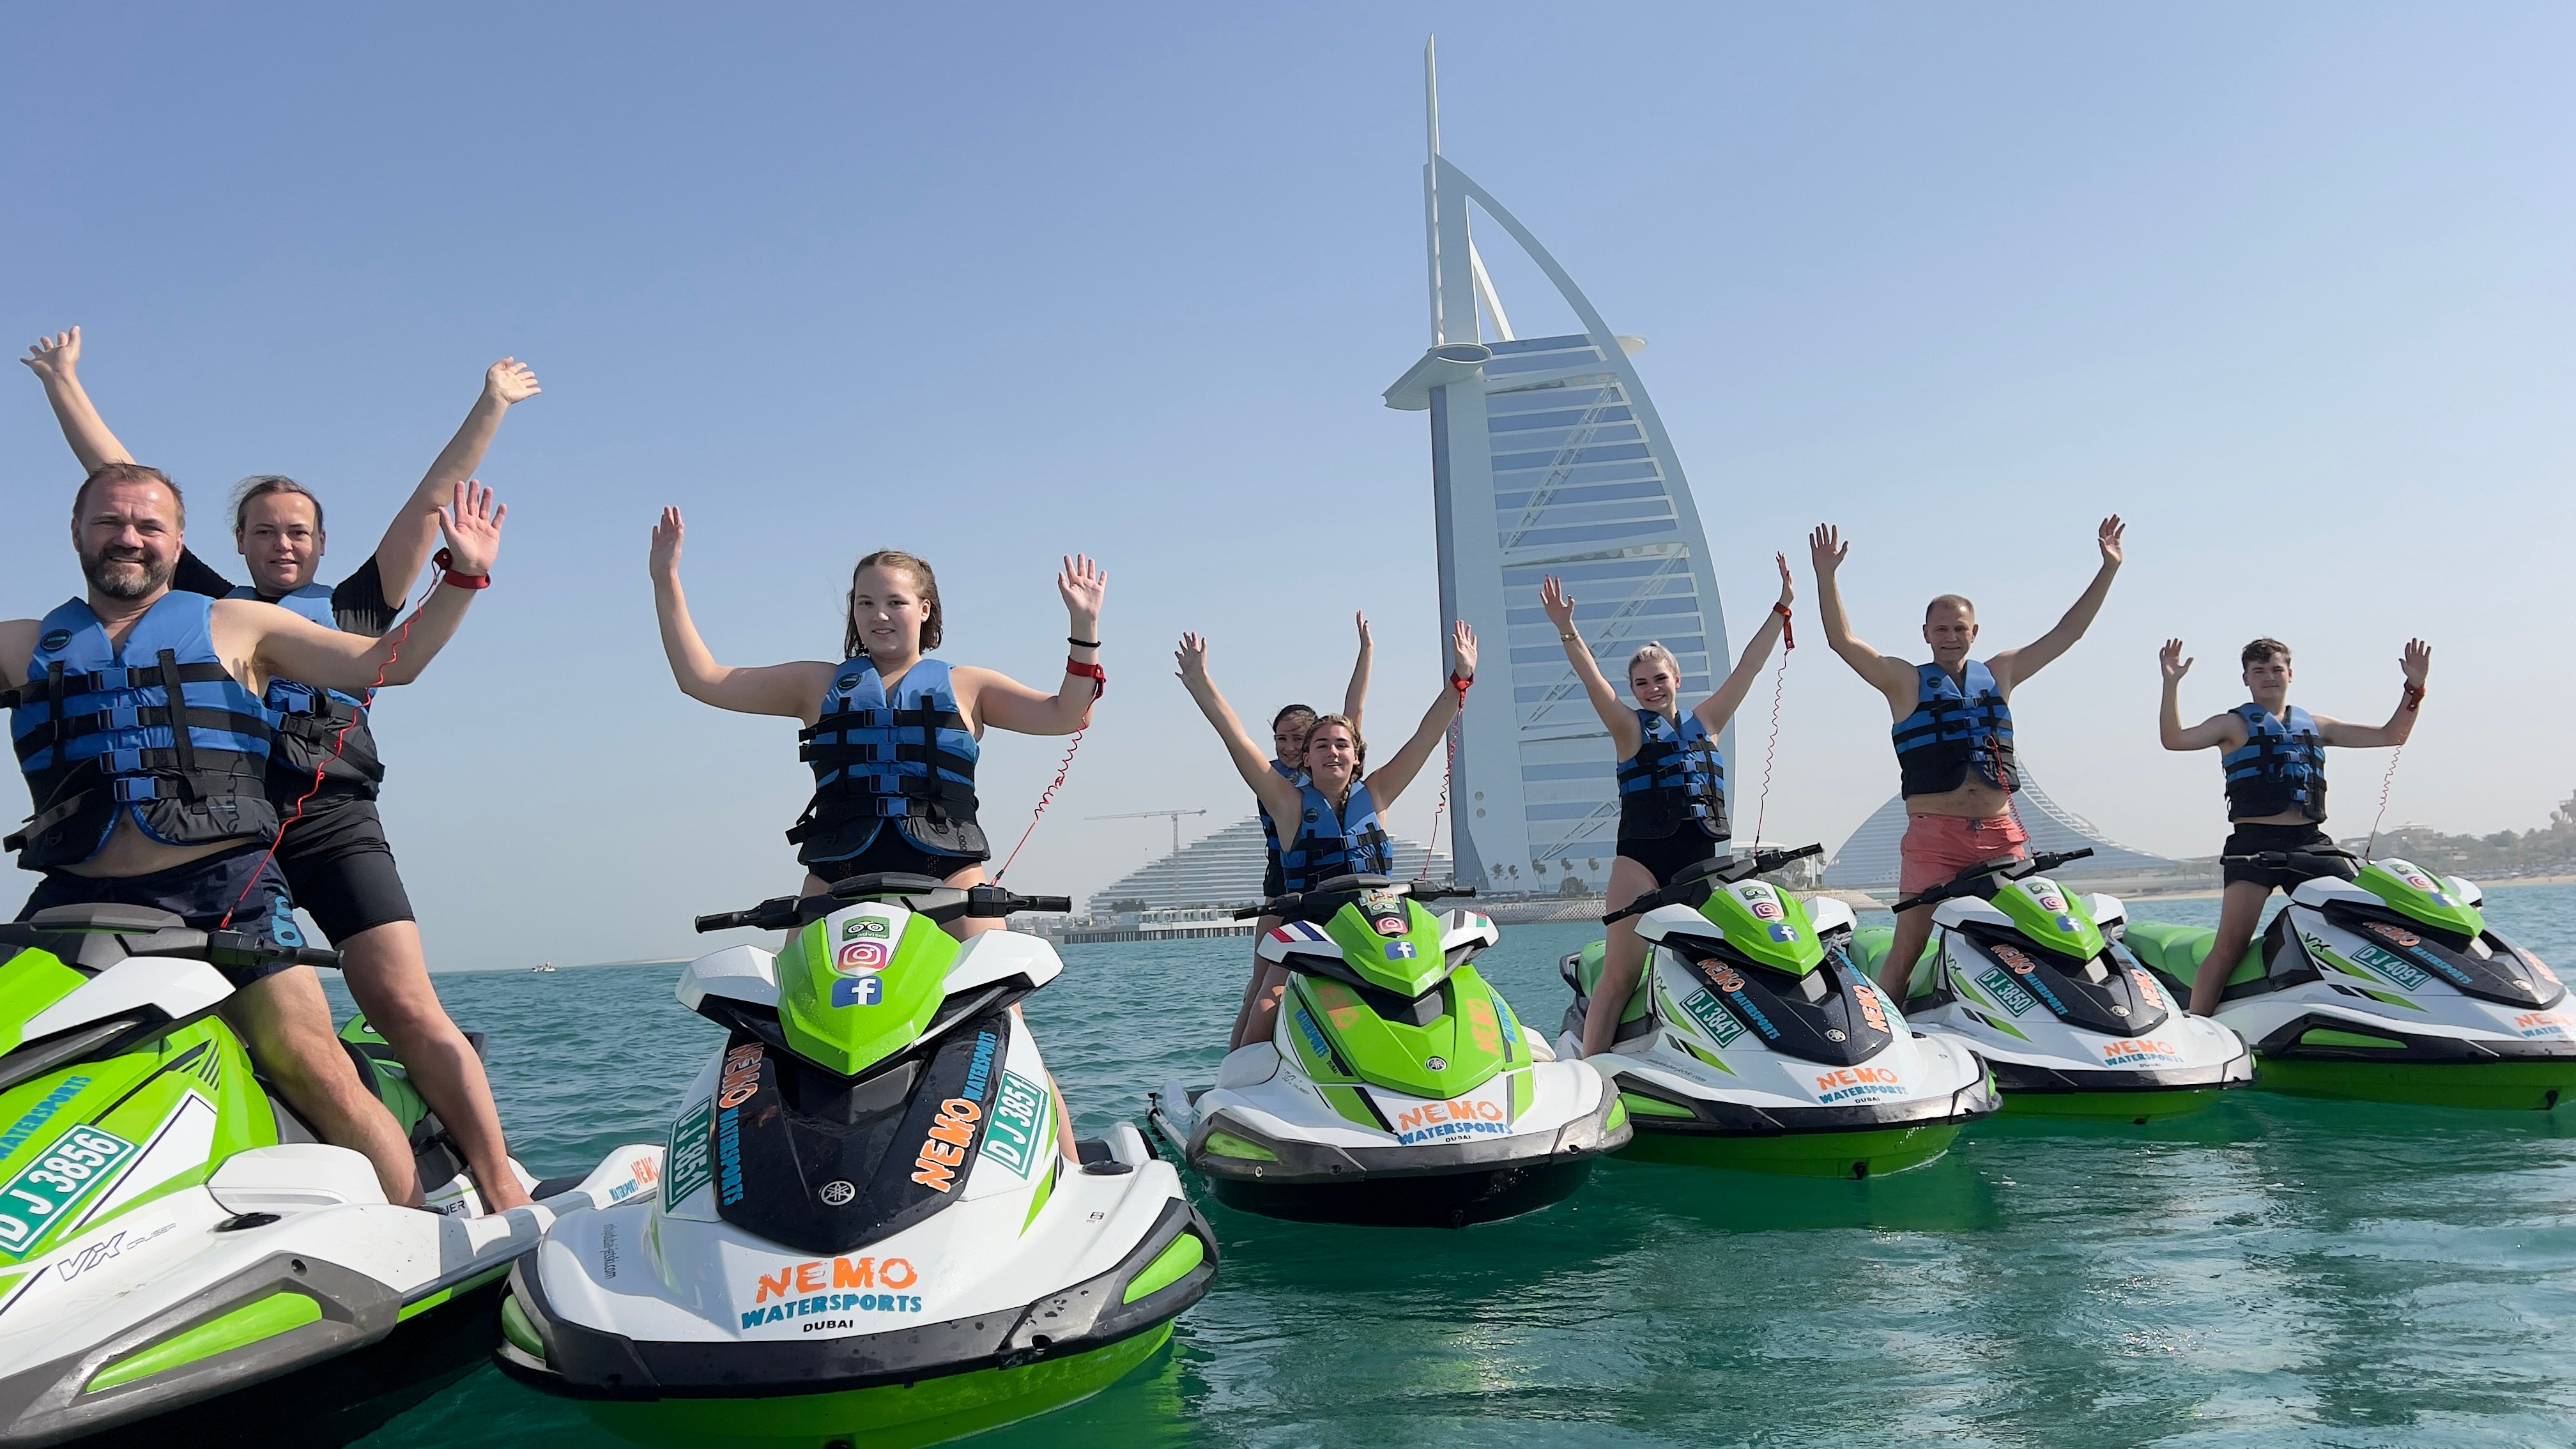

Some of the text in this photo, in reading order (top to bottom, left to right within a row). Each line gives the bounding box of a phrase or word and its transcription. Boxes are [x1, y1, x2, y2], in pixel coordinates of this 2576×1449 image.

[1397, 941, 1412, 958] f
[1781, 925, 1795, 941] f
[2305, 933, 2331, 954] VX
[1990, 944, 2069, 1015] NEMO WATERSPORTS
[2358, 947, 2426, 986] D J 4091
[2409, 946, 2474, 985] WATERSPORTS
[852, 978, 876, 1005] f
[1697, 958, 1781, 1039] NEMO WATERSPORTS
[1853, 985, 1890, 1034] NEMO
[1982, 969, 2032, 1011] D J 3850
[1294, 1007, 1330, 1059] WATERSPORTS
[1466, 999, 1500, 1056] NEMO
[1685, 990, 1740, 1039] D J 3847
[2103, 1039, 2175, 1057] NEMO
[1816, 1067, 1899, 1091] NEMO
[719, 1042, 764, 1206] NEMO WATERSPORTS
[911, 1031, 997, 1193] NEMO WATERSPORTS
[987, 1075, 1038, 1167] D J 3851
[1399, 1100, 1503, 1131] NEMO
[674, 1100, 710, 1196] D J 3851
[1397, 1123, 1514, 1146] WATERSPORTS
[0, 1133, 119, 1242] D J 3856
[631, 1156, 659, 1186] NEMO
[57, 1230, 127, 1282] VX
[755, 1255, 918, 1305] NEMO
[741, 1293, 922, 1330] WATERSPORTS
[803, 1320, 854, 1333] DUBAI
